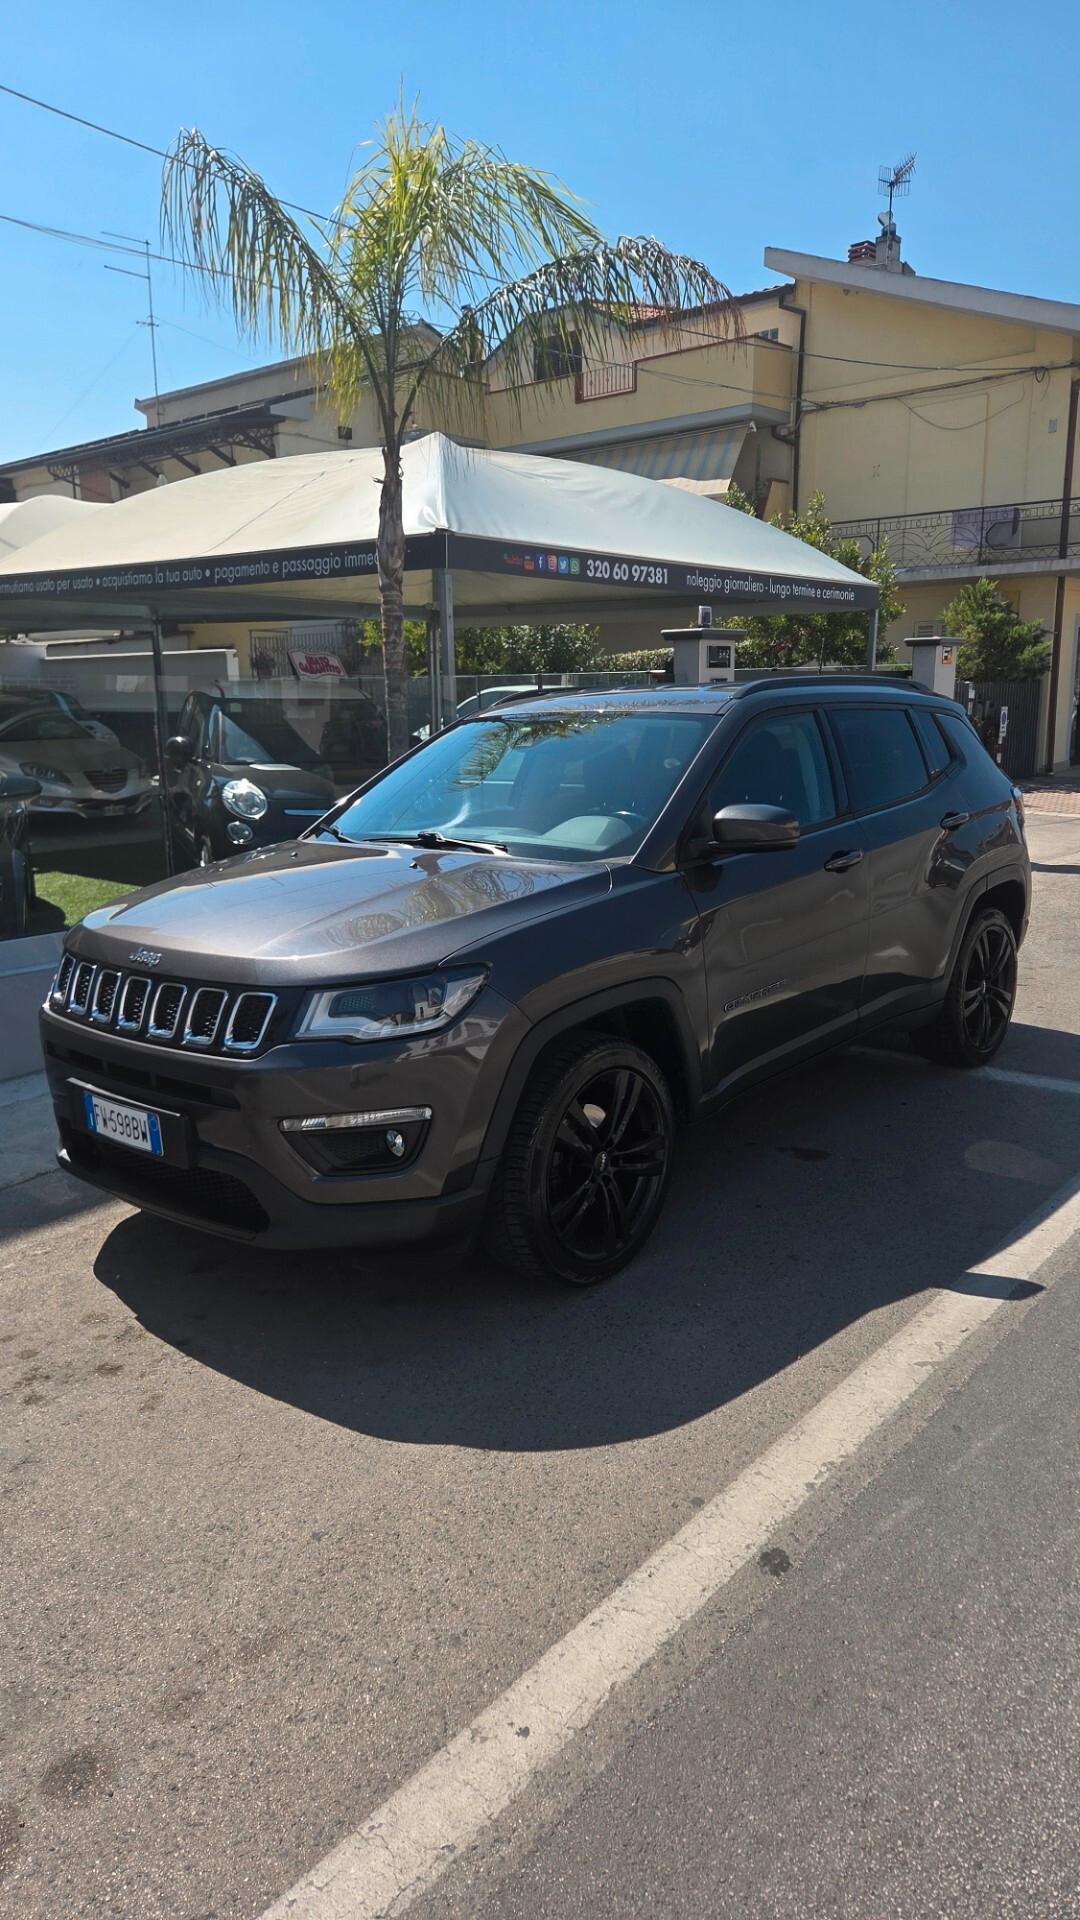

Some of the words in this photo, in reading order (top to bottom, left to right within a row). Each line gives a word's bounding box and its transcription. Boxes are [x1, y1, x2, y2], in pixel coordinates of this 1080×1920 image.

[35, 579, 55, 592] usato
[56, 579, 71, 595] per
[72, 577, 94, 589] usato
[102, 571, 153, 591] acquistiamo
[155, 568, 164, 583] la
[166, 571, 180, 583] tua
[182, 567, 202, 580] auto
[214, 560, 270, 584] pagamento
[272, 563, 279, 573] e
[282, 553, 342, 578] passaggio
[586, 559, 610, 579] 320
[613, 563, 629, 581] 60
[631, 564, 669, 585] 97381
[686, 569, 722, 593] noleggio
[724, 575, 764, 594] giornaliero
[769, 578, 791, 599] lungo
[792, 583, 815, 598] termine
[816, 588, 821, 598] e
[822, 588, 855, 601] cerimonie
